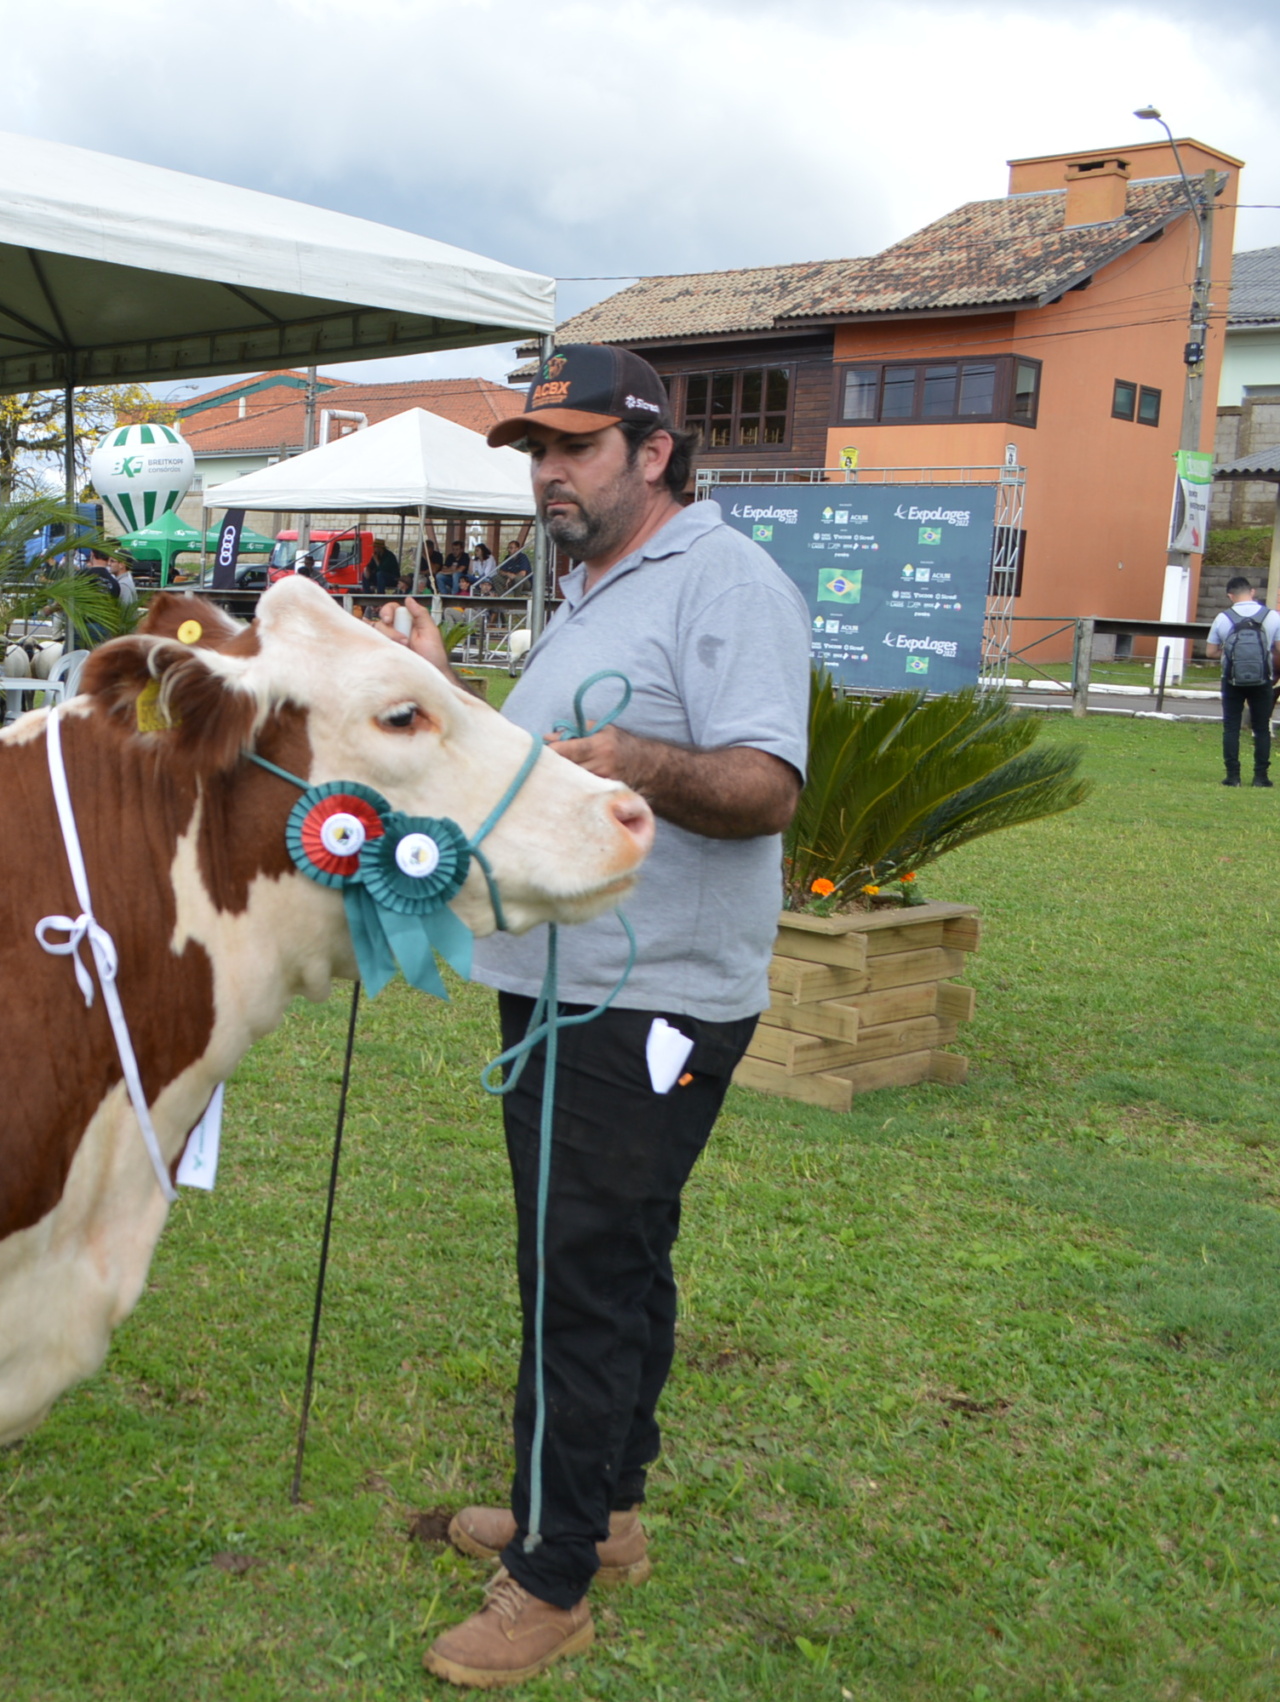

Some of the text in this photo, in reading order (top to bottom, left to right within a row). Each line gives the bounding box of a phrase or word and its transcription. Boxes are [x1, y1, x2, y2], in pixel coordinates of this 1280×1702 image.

[532, 381, 571, 399] ACBX
[743, 505, 798, 522] ExpoLages
[908, 506, 971, 524] ExpoLages
[896, 634, 958, 655] ExpoLages
